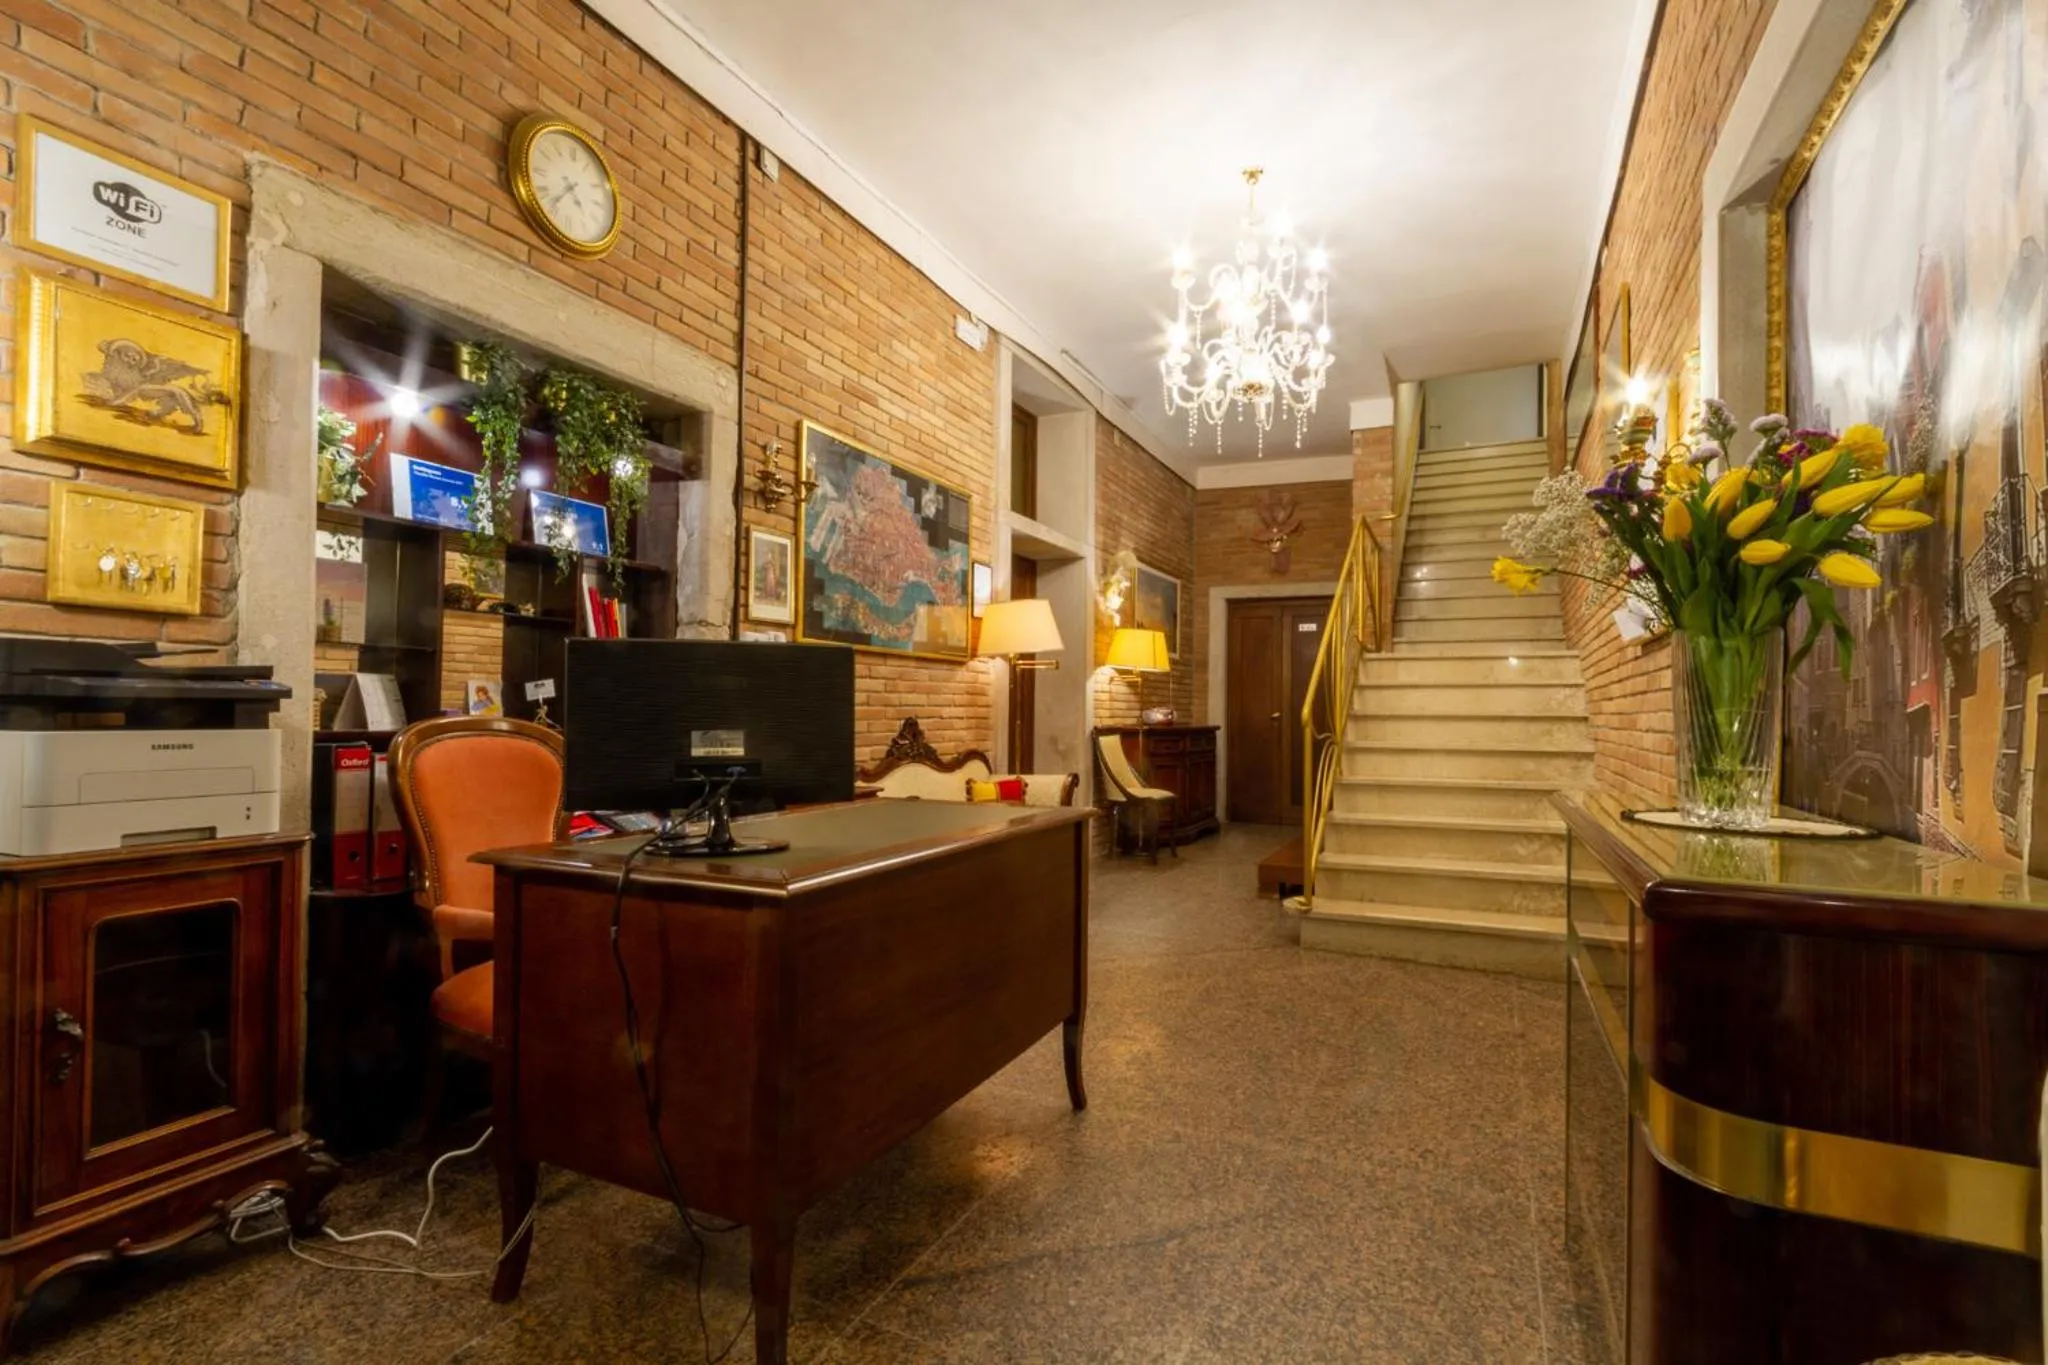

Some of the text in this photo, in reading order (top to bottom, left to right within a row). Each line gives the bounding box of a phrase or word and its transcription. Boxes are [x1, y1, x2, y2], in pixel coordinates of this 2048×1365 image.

[105, 215, 147, 239] ZONE
[151, 743, 194, 751] SAMSUNG
[341, 758, 369, 767] Oxford
